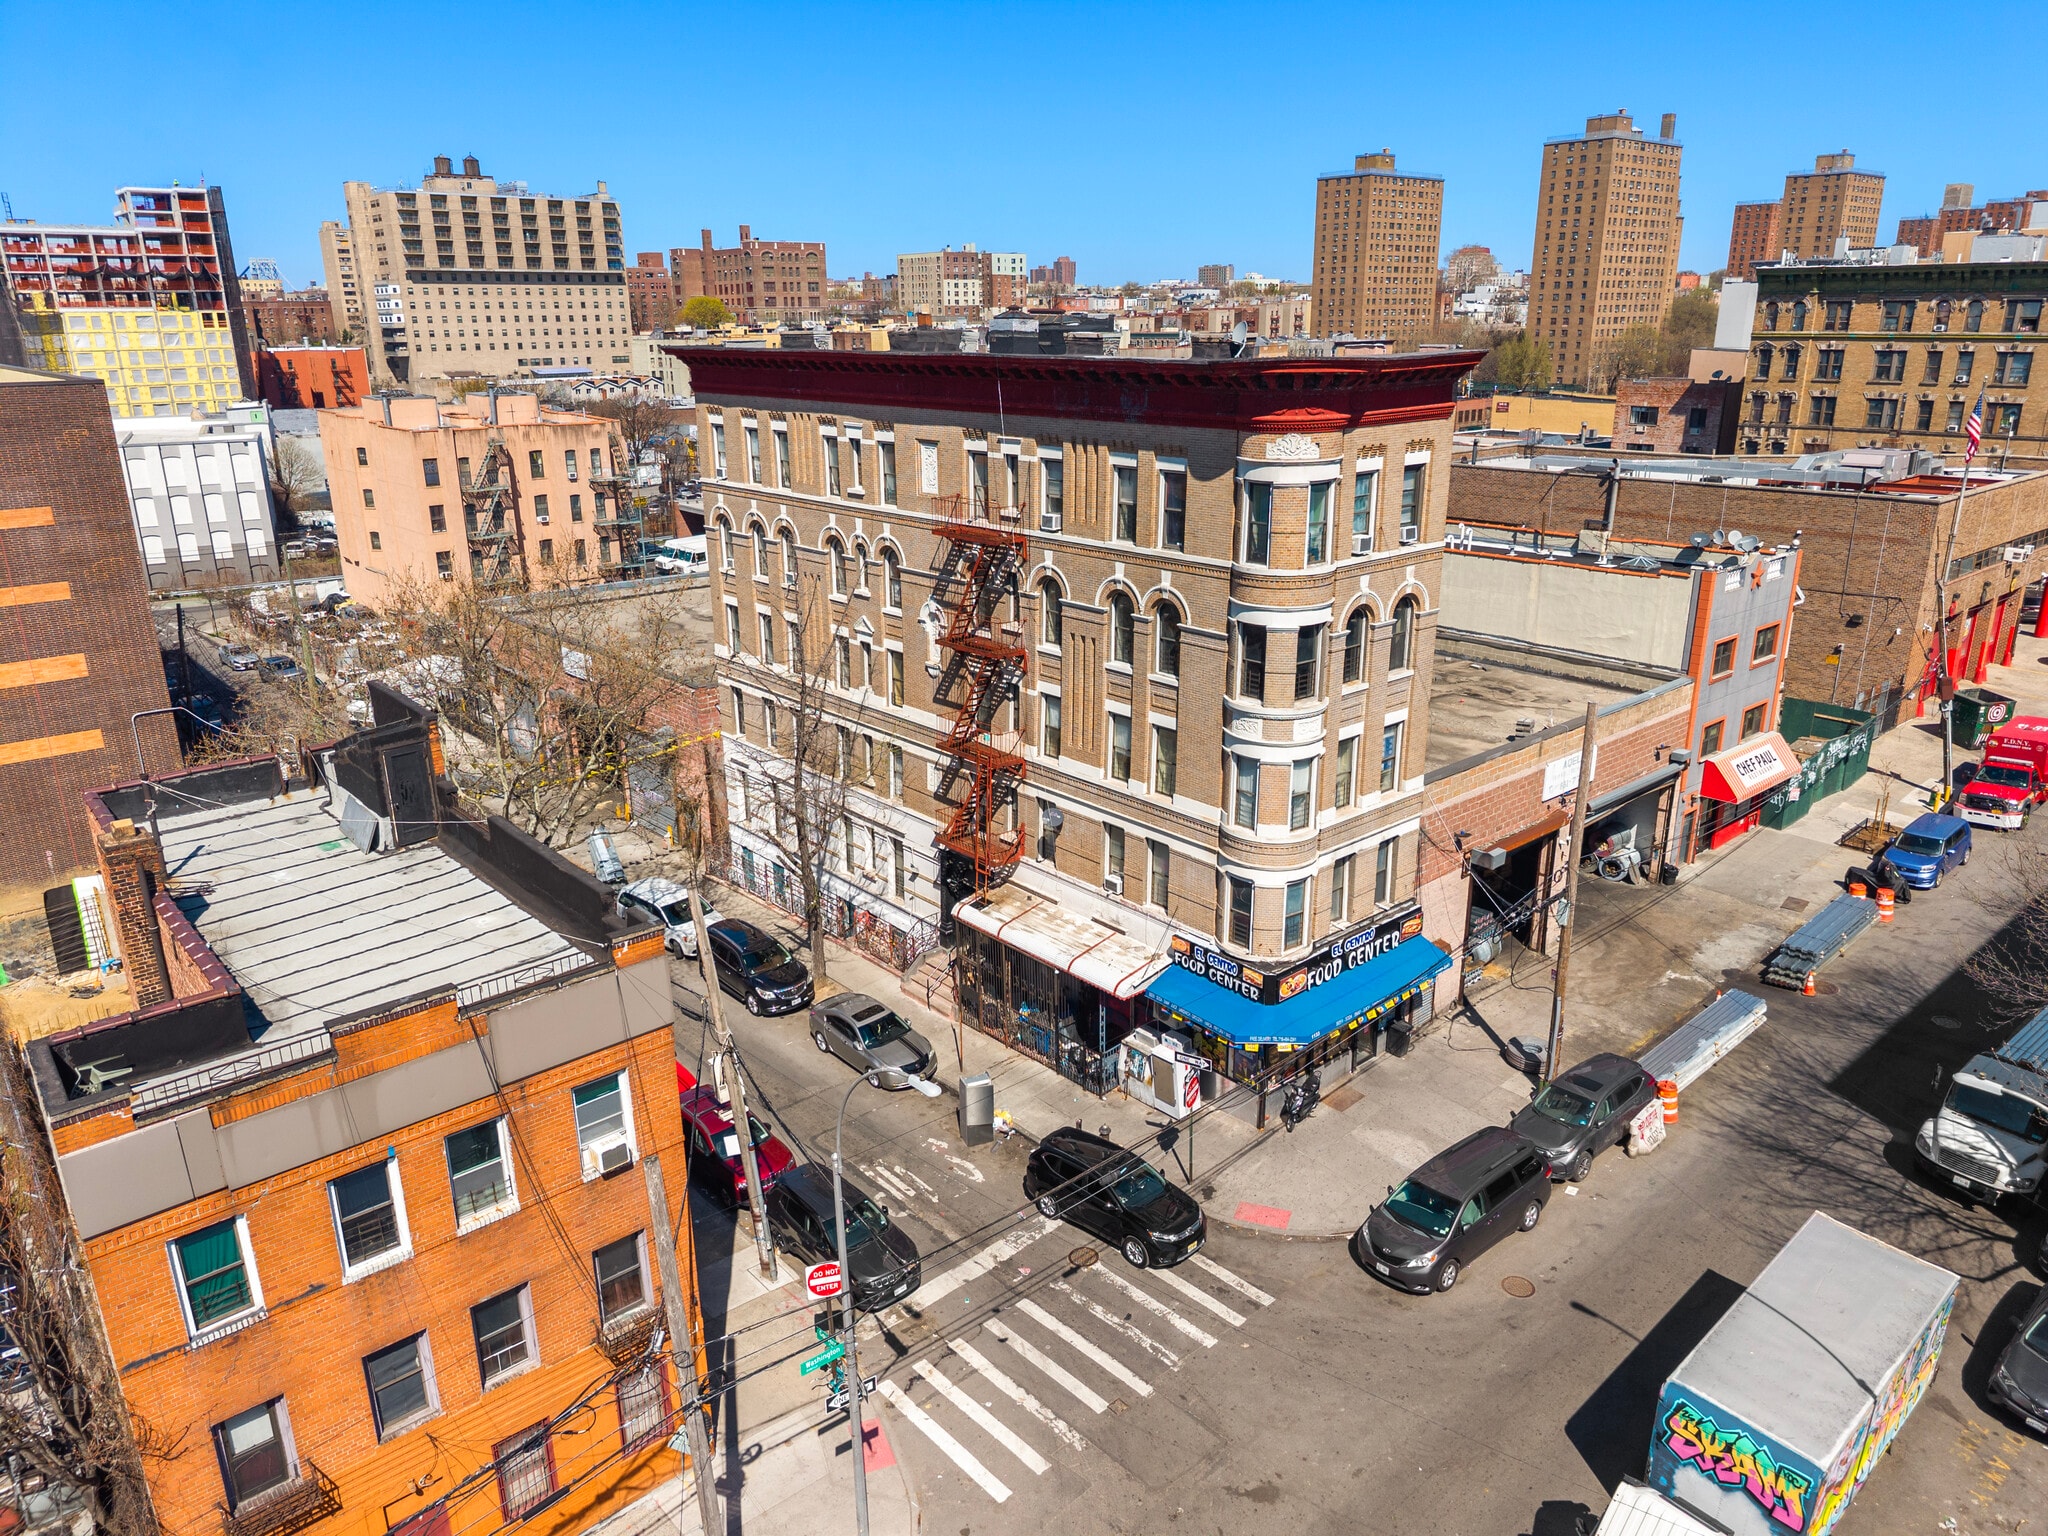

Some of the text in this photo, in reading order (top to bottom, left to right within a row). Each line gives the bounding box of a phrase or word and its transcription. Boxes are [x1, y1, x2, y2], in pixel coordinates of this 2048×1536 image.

[1736, 750, 1777, 776] CHEF PAUL
[1332, 927, 1376, 958] EL CENTRO
[1195, 946, 1238, 976] EL CENTRO
[1307, 930, 1400, 991] FOOD CENTER
[1174, 952, 1259, 1001] FOOD CENTER
[813, 1267, 839, 1278] DO NOT
[816, 1282, 839, 1292] ENTER
[805, 1346, 841, 1369] Washington
[833, 1394, 848, 1406] ONE
